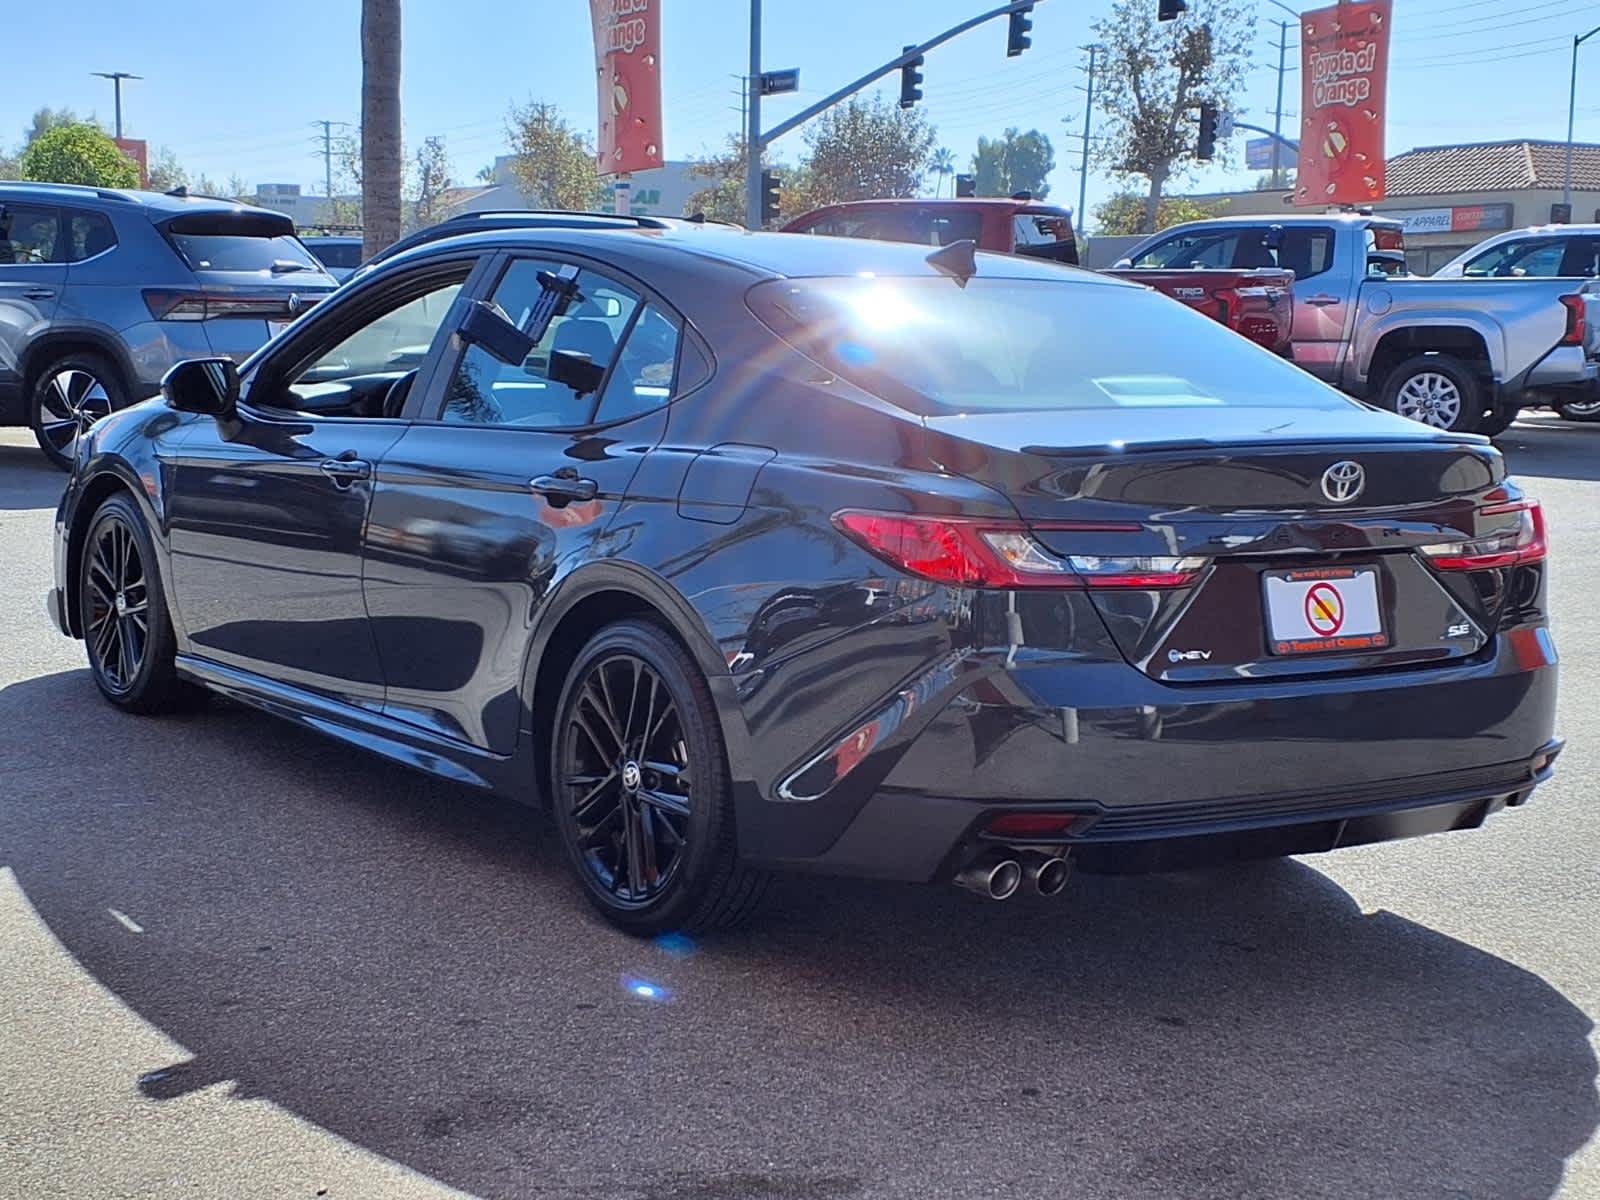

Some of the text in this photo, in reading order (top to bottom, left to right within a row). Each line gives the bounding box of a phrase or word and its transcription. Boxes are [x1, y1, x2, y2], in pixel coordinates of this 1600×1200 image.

[1310, 42, 1376, 80] Toyota of
[1312, 77, 1370, 107] Orange
[1447, 624, 1470, 637] SE
[1325, 639, 1336, 648] of
